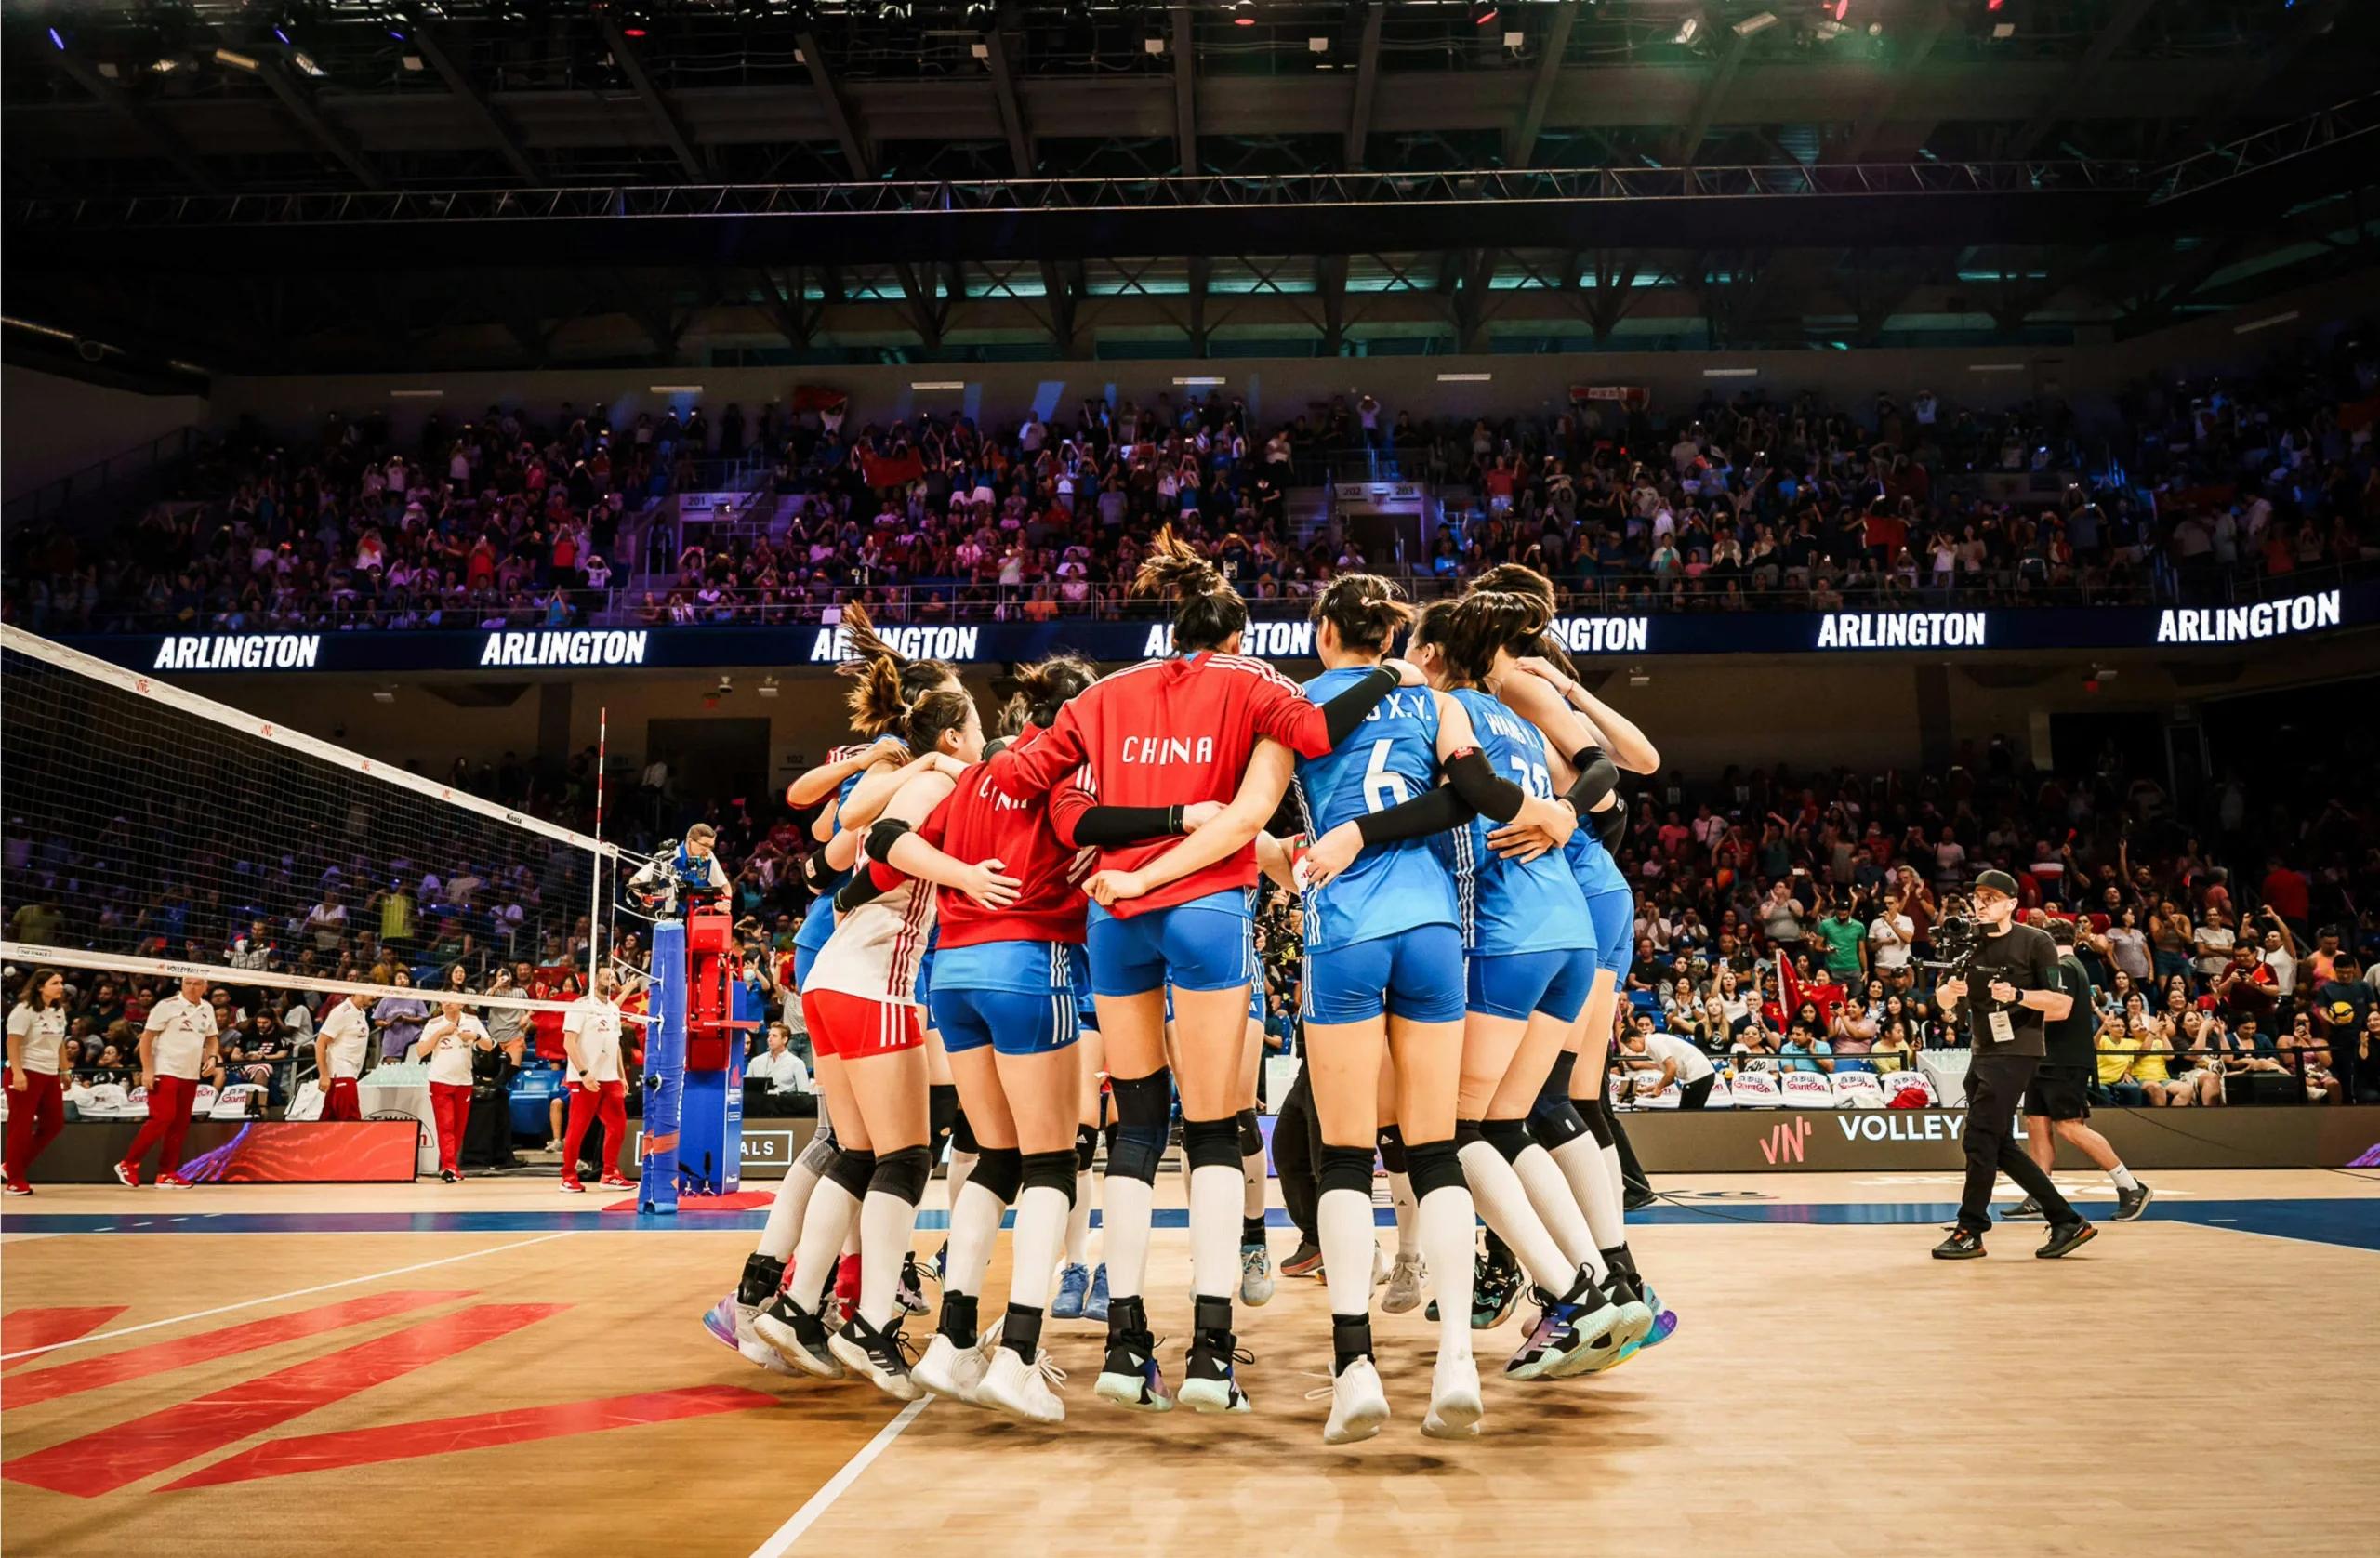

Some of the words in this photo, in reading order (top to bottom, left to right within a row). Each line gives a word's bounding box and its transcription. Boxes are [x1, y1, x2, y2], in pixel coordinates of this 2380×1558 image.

[688, 496, 706, 506] 201
[1818, 613, 1986, 647] ARLINGTON
[2158, 590, 2340, 642] ARLINGTON
[480, 631, 648, 666] ARLINGTON
[811, 627, 978, 661] ARNGTON
[1549, 617, 1648, 651] NGTON
[153, 635, 321, 669] ARLINGTON
[1122, 735, 1213, 765] CHINA
[1363, 738, 1411, 814] 6
[1837, 1114, 2030, 1141] VOLLEYL
